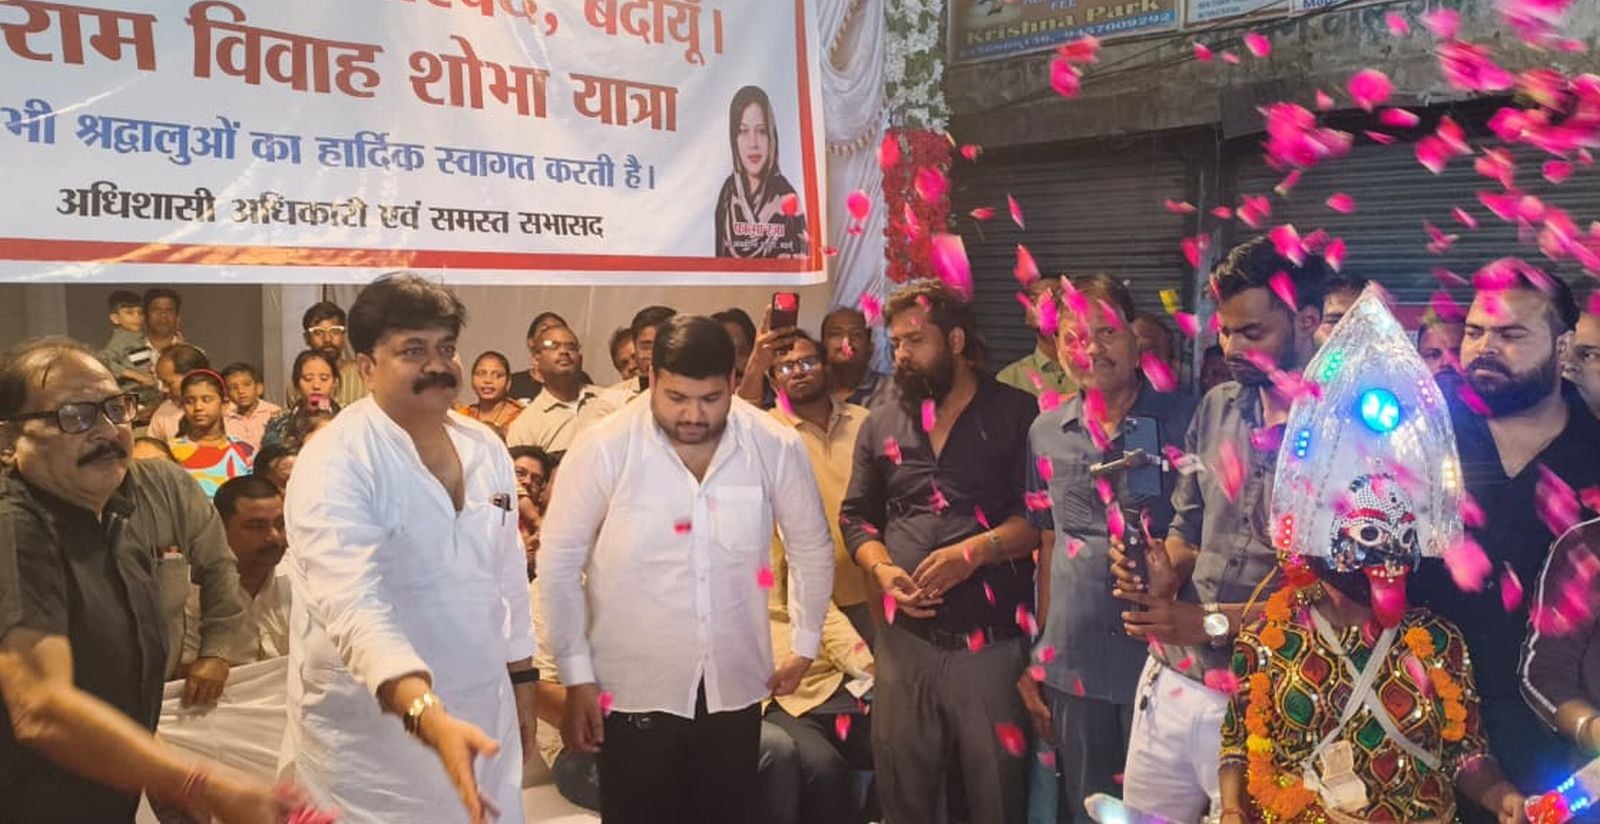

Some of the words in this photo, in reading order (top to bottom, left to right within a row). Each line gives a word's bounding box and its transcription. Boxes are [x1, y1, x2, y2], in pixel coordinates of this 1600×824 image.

[966, 17, 1075, 45] Krishna
[1086, 0, 1160, 22] Park
[0, 1, 157, 71] राम
[185, 0, 383, 98] विवाह
[409, 35, 549, 119] शोभा
[569, 72, 678, 132] यात्रा
[250, 131, 302, 164] का
[315, 131, 424, 172] हार्दिक
[435, 146, 535, 182] स्वागत
[546, 153, 615, 187] करती
[57, 181, 215, 222] अधिशासी
[231, 191, 367, 228] अधिकारी
[378, 200, 421, 229] एवं
[429, 206, 509, 235] समस्त
[519, 211, 605, 239] सभासद
